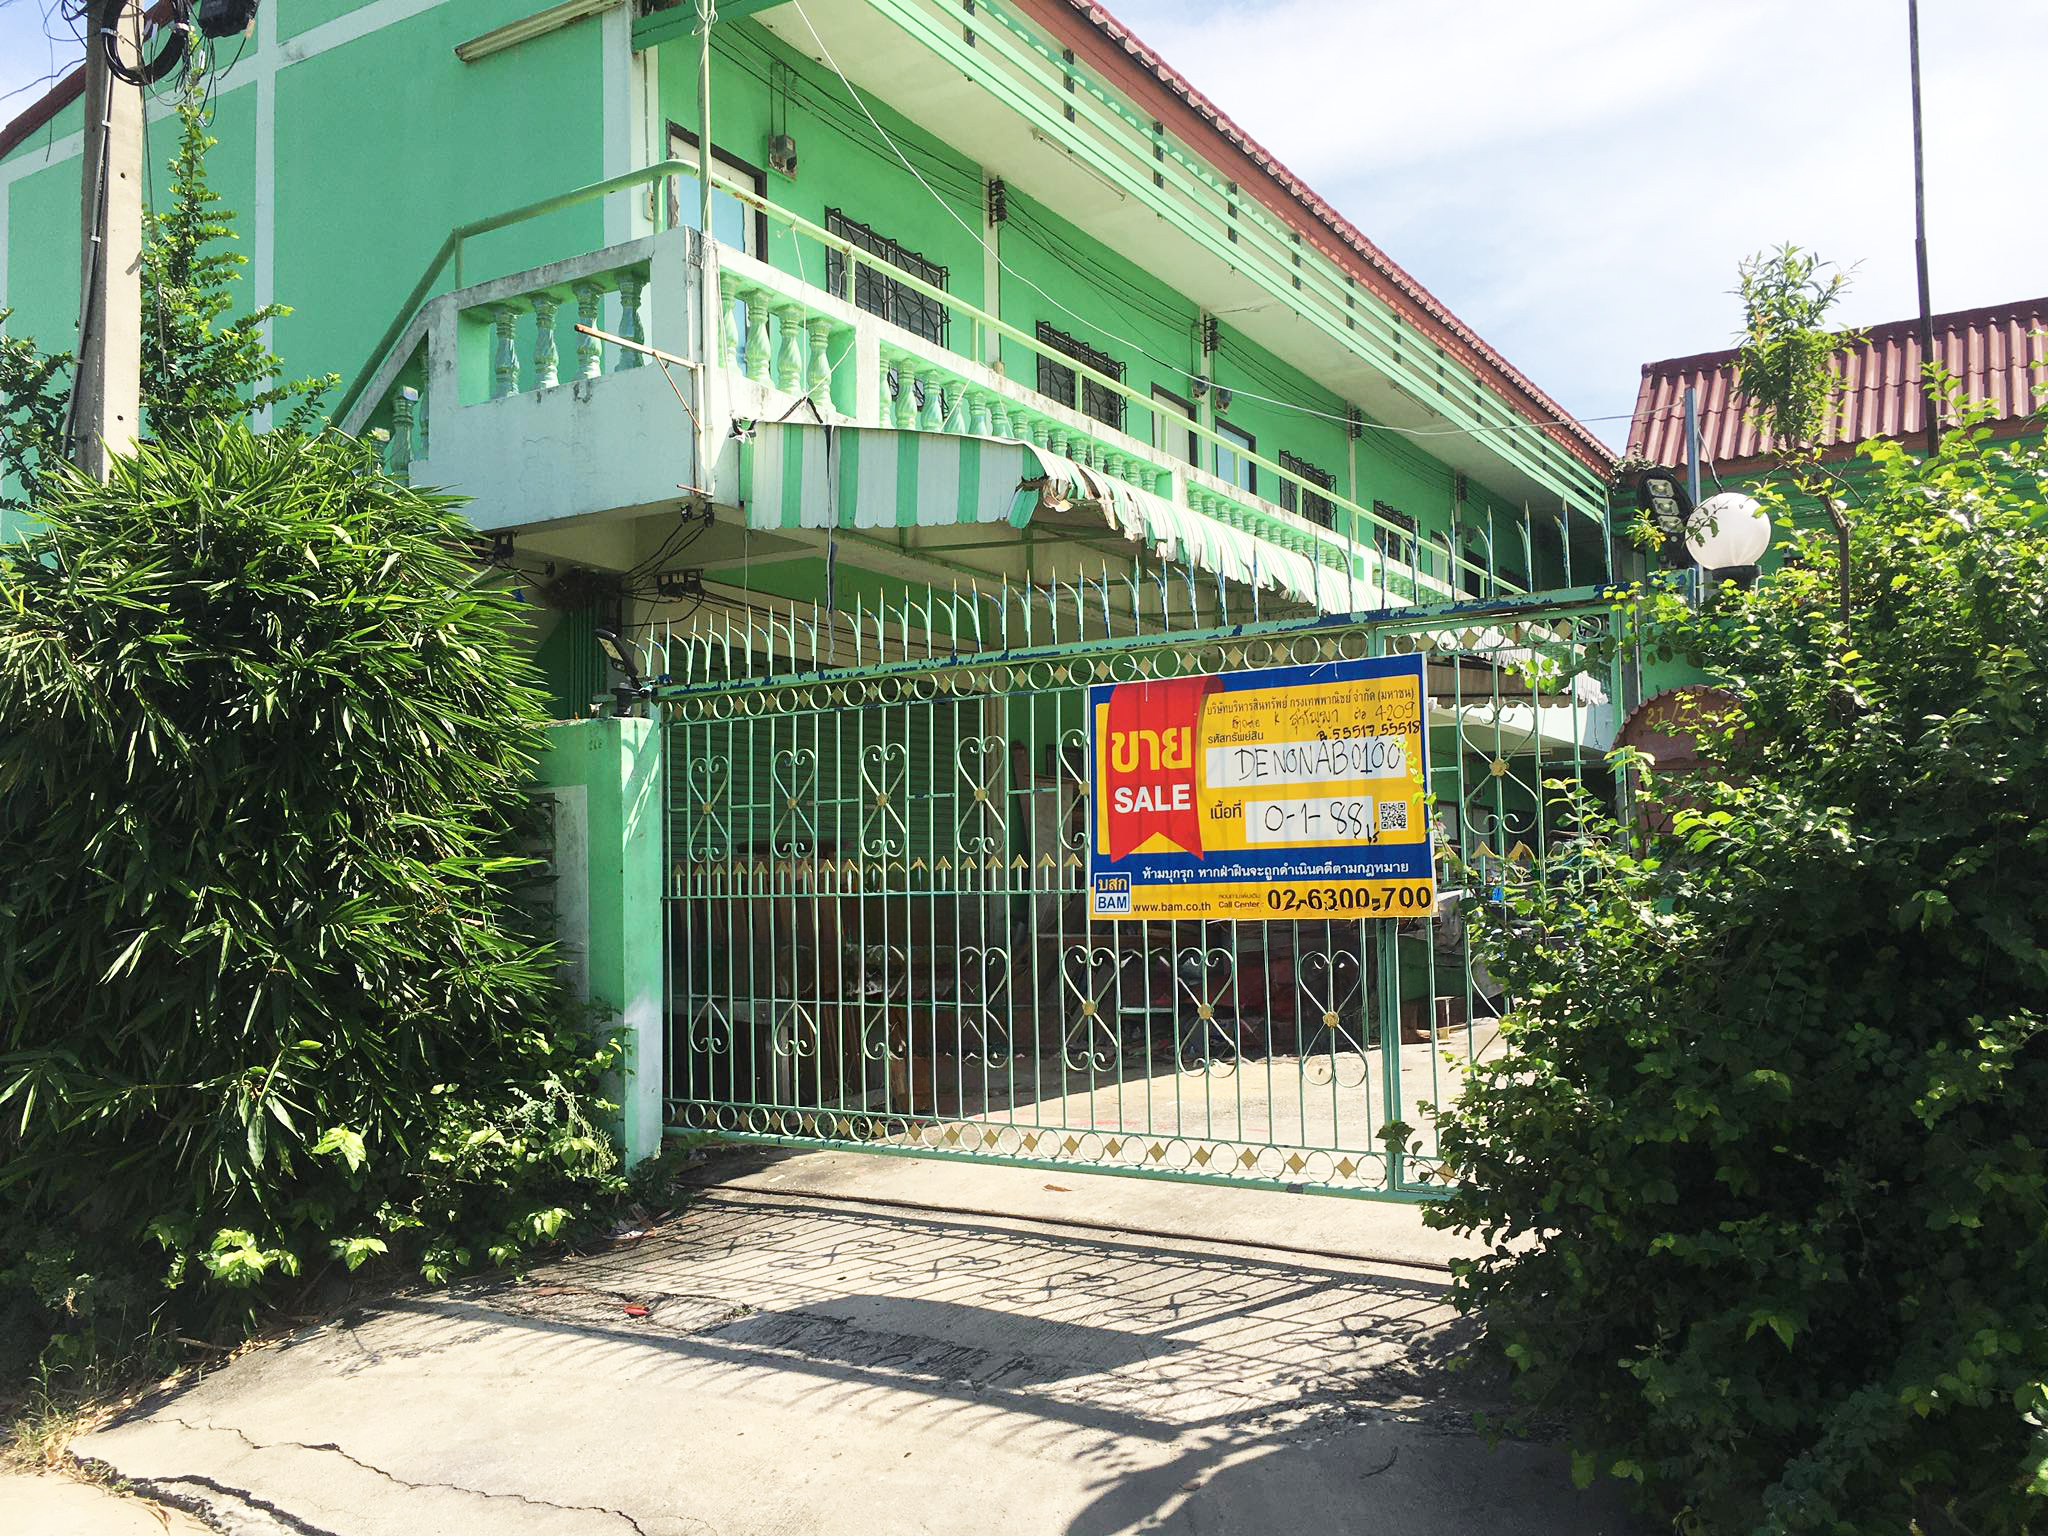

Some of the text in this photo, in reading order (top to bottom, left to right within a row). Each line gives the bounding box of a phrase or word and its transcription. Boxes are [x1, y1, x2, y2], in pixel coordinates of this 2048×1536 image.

[1353, 686, 1377, 703] จำกัด
[1377, 687, 1416, 703] (มหาชน)
[1375, 701, 1416, 723] 4209
[1111, 726, 1192, 773] ขาย
[1114, 783, 1191, 814] SALE
[1210, 799, 1243, 820] เนื้อที่
[1141, 866, 1194, 883] ห้ามบุกรุก
[1098, 877, 1128, 892] บสก
[1097, 895, 1128, 910] BAM
[1133, 901, 1212, 912] www.bam.co.th
[1218, 900, 1233, 909] Call
[1266, 886, 1432, 912] 02-6300-700
